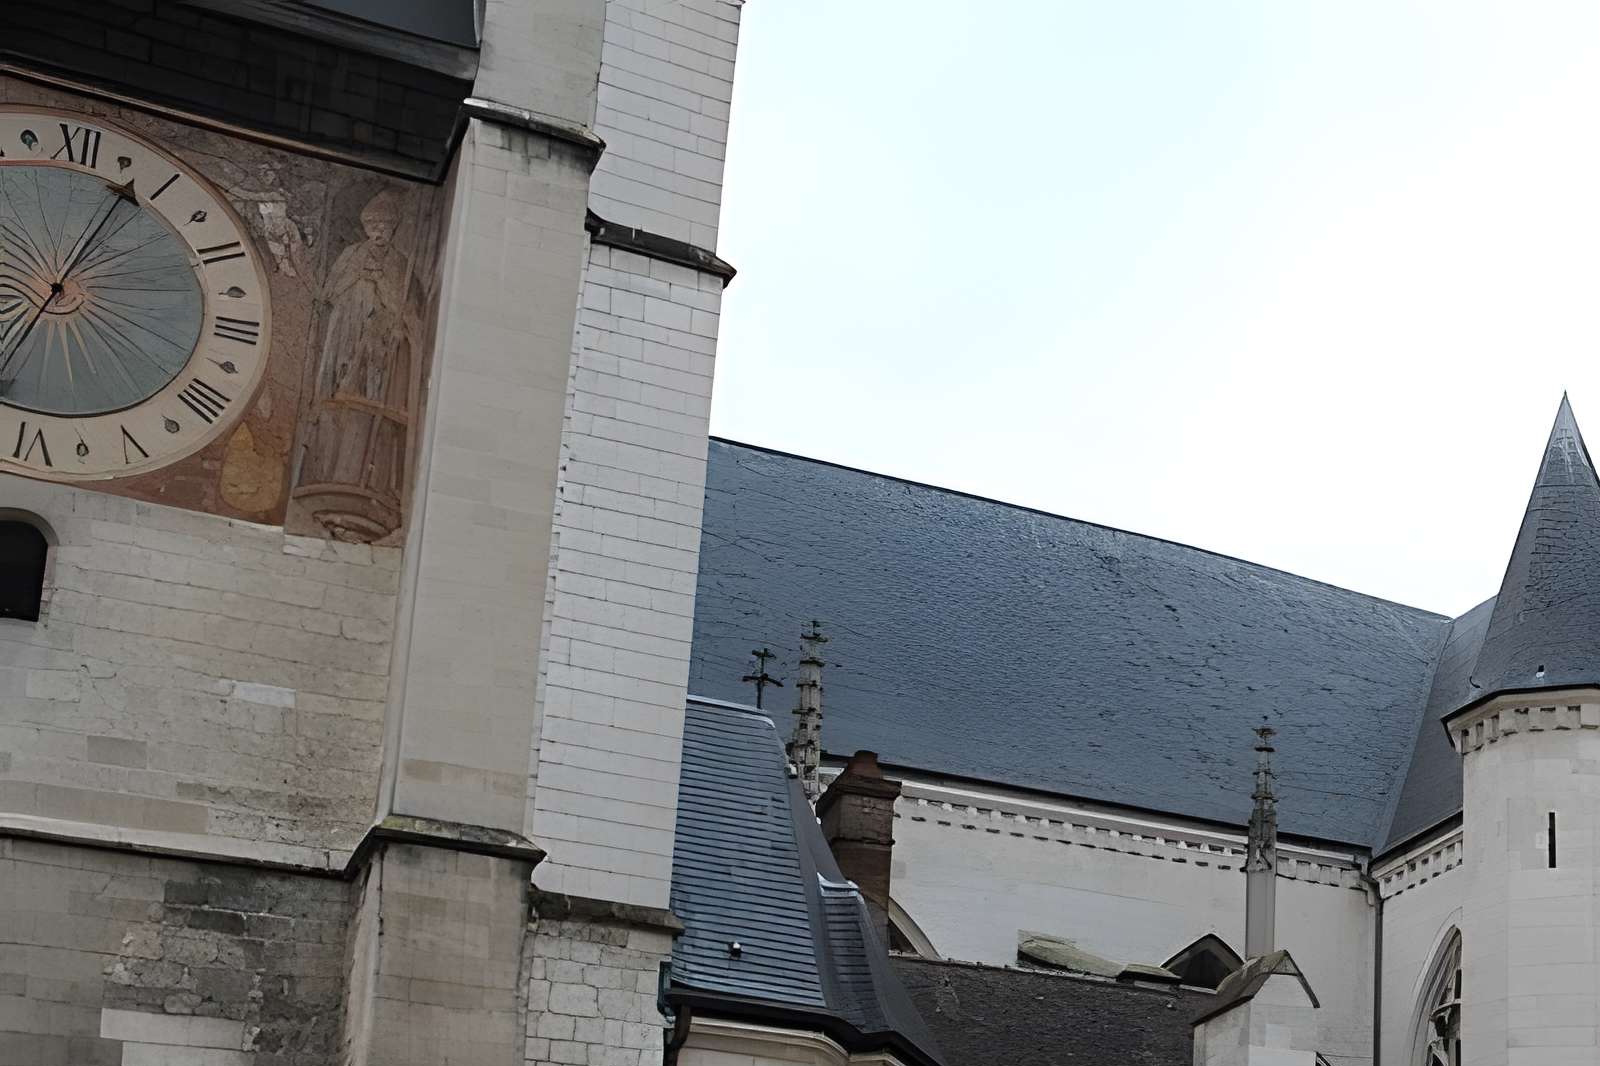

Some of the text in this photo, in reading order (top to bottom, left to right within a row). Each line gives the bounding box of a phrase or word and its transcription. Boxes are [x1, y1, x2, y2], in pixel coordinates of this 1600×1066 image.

[50, 123, 102, 169] XII
[149, 173, 182, 201] I
[196, 240, 246, 264] II
[213, 315, 261, 346] III
[176, 377, 233, 424] IIII
[12, 421, 53, 467] VI
[120, 424, 149, 464] V
